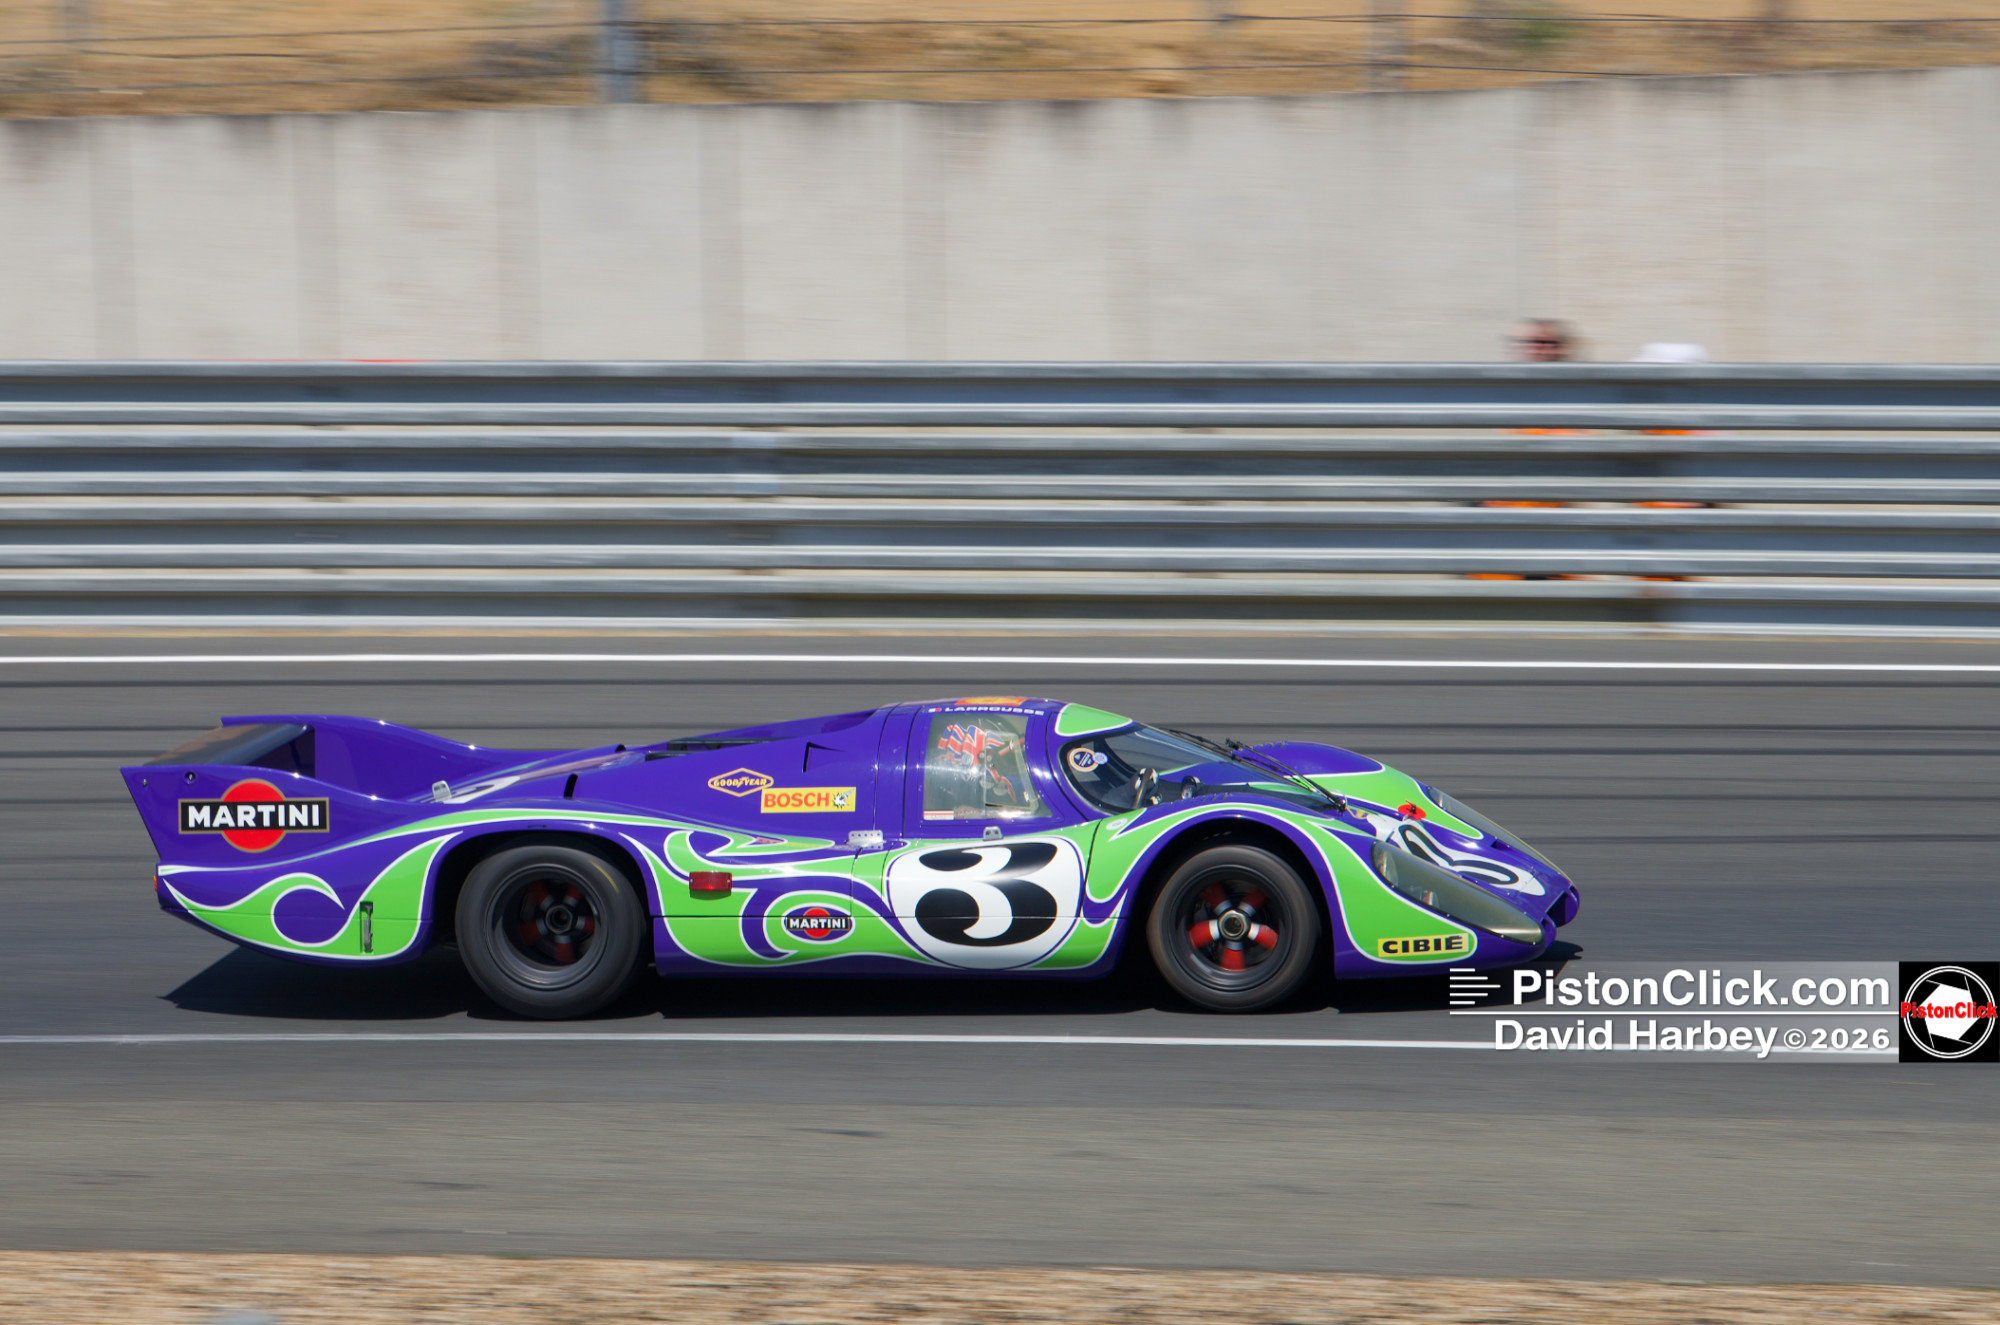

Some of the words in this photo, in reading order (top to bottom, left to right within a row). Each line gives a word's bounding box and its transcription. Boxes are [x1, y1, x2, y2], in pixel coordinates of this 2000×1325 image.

[764, 792, 830, 808] BOSCH
[188, 804, 320, 828] MARTINI
[914, 842, 1058, 947] 3
[789, 917, 846, 929] MARTINI
